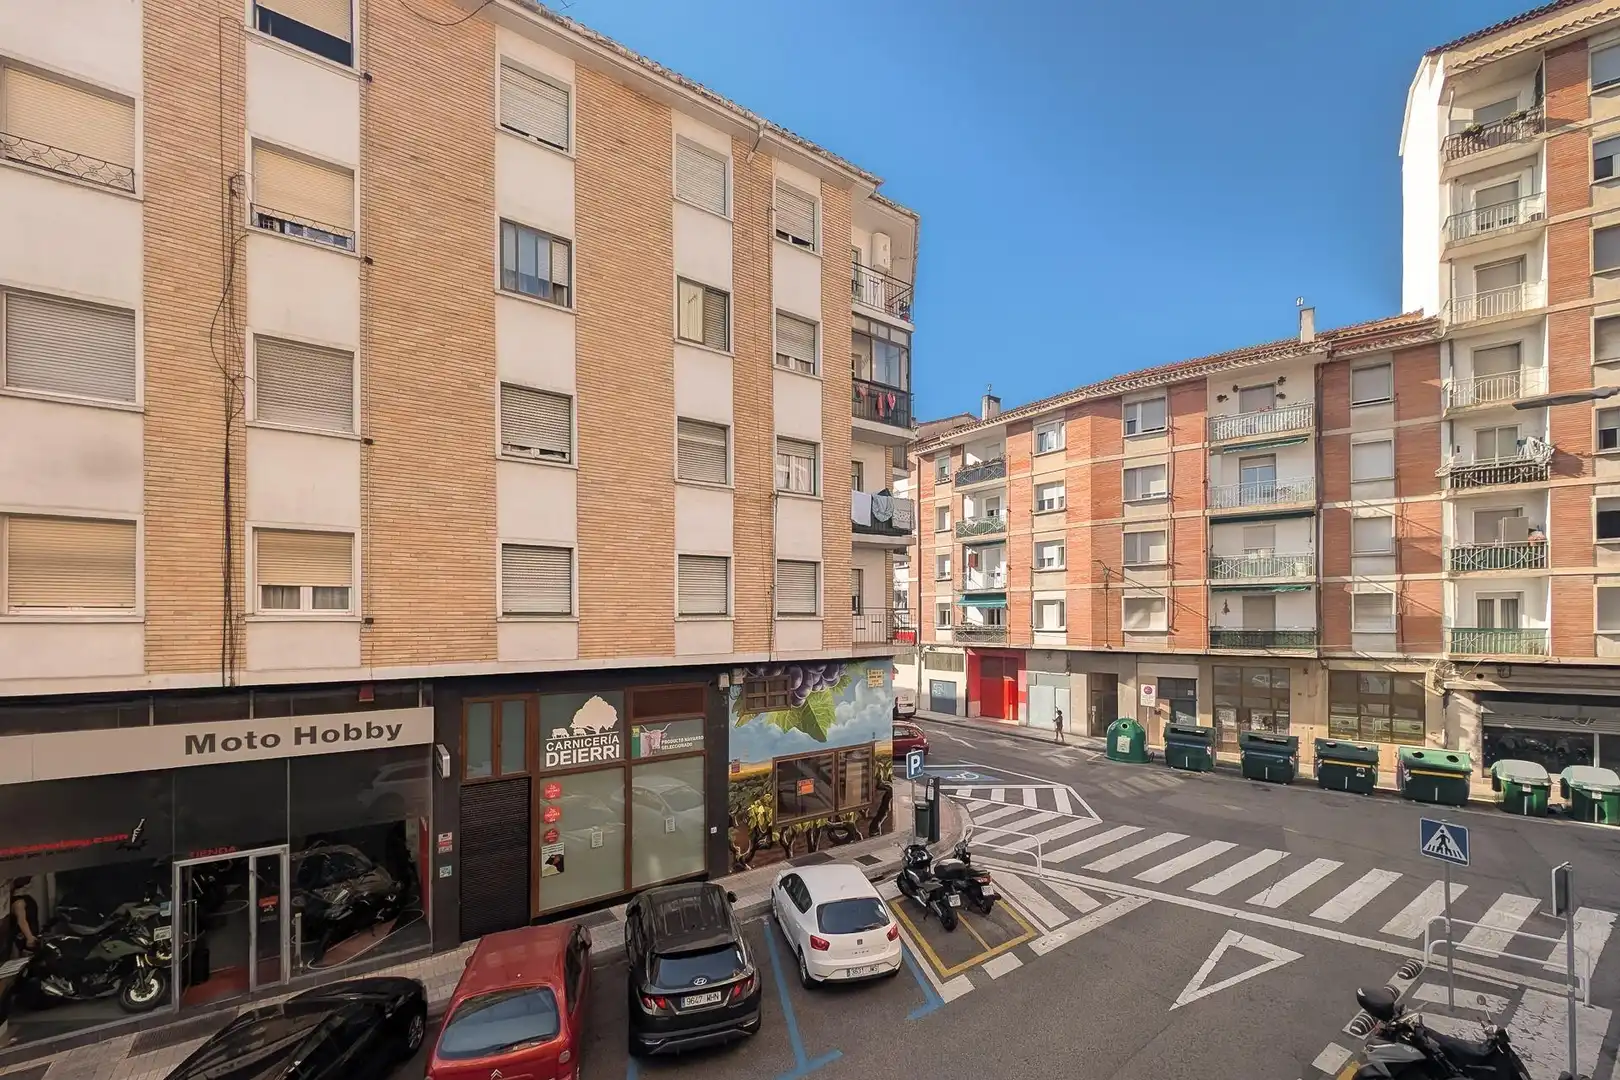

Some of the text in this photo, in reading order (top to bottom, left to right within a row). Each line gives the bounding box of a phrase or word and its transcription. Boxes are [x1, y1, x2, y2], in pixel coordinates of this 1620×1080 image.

[184, 721, 403, 755] Moto Hobby
[546, 734, 620, 752] CARNICERÍA
[661, 737, 684, 745] PRODUCTO
[546, 744, 620, 767] DEIERRI
[911, 755, 920, 775] P
